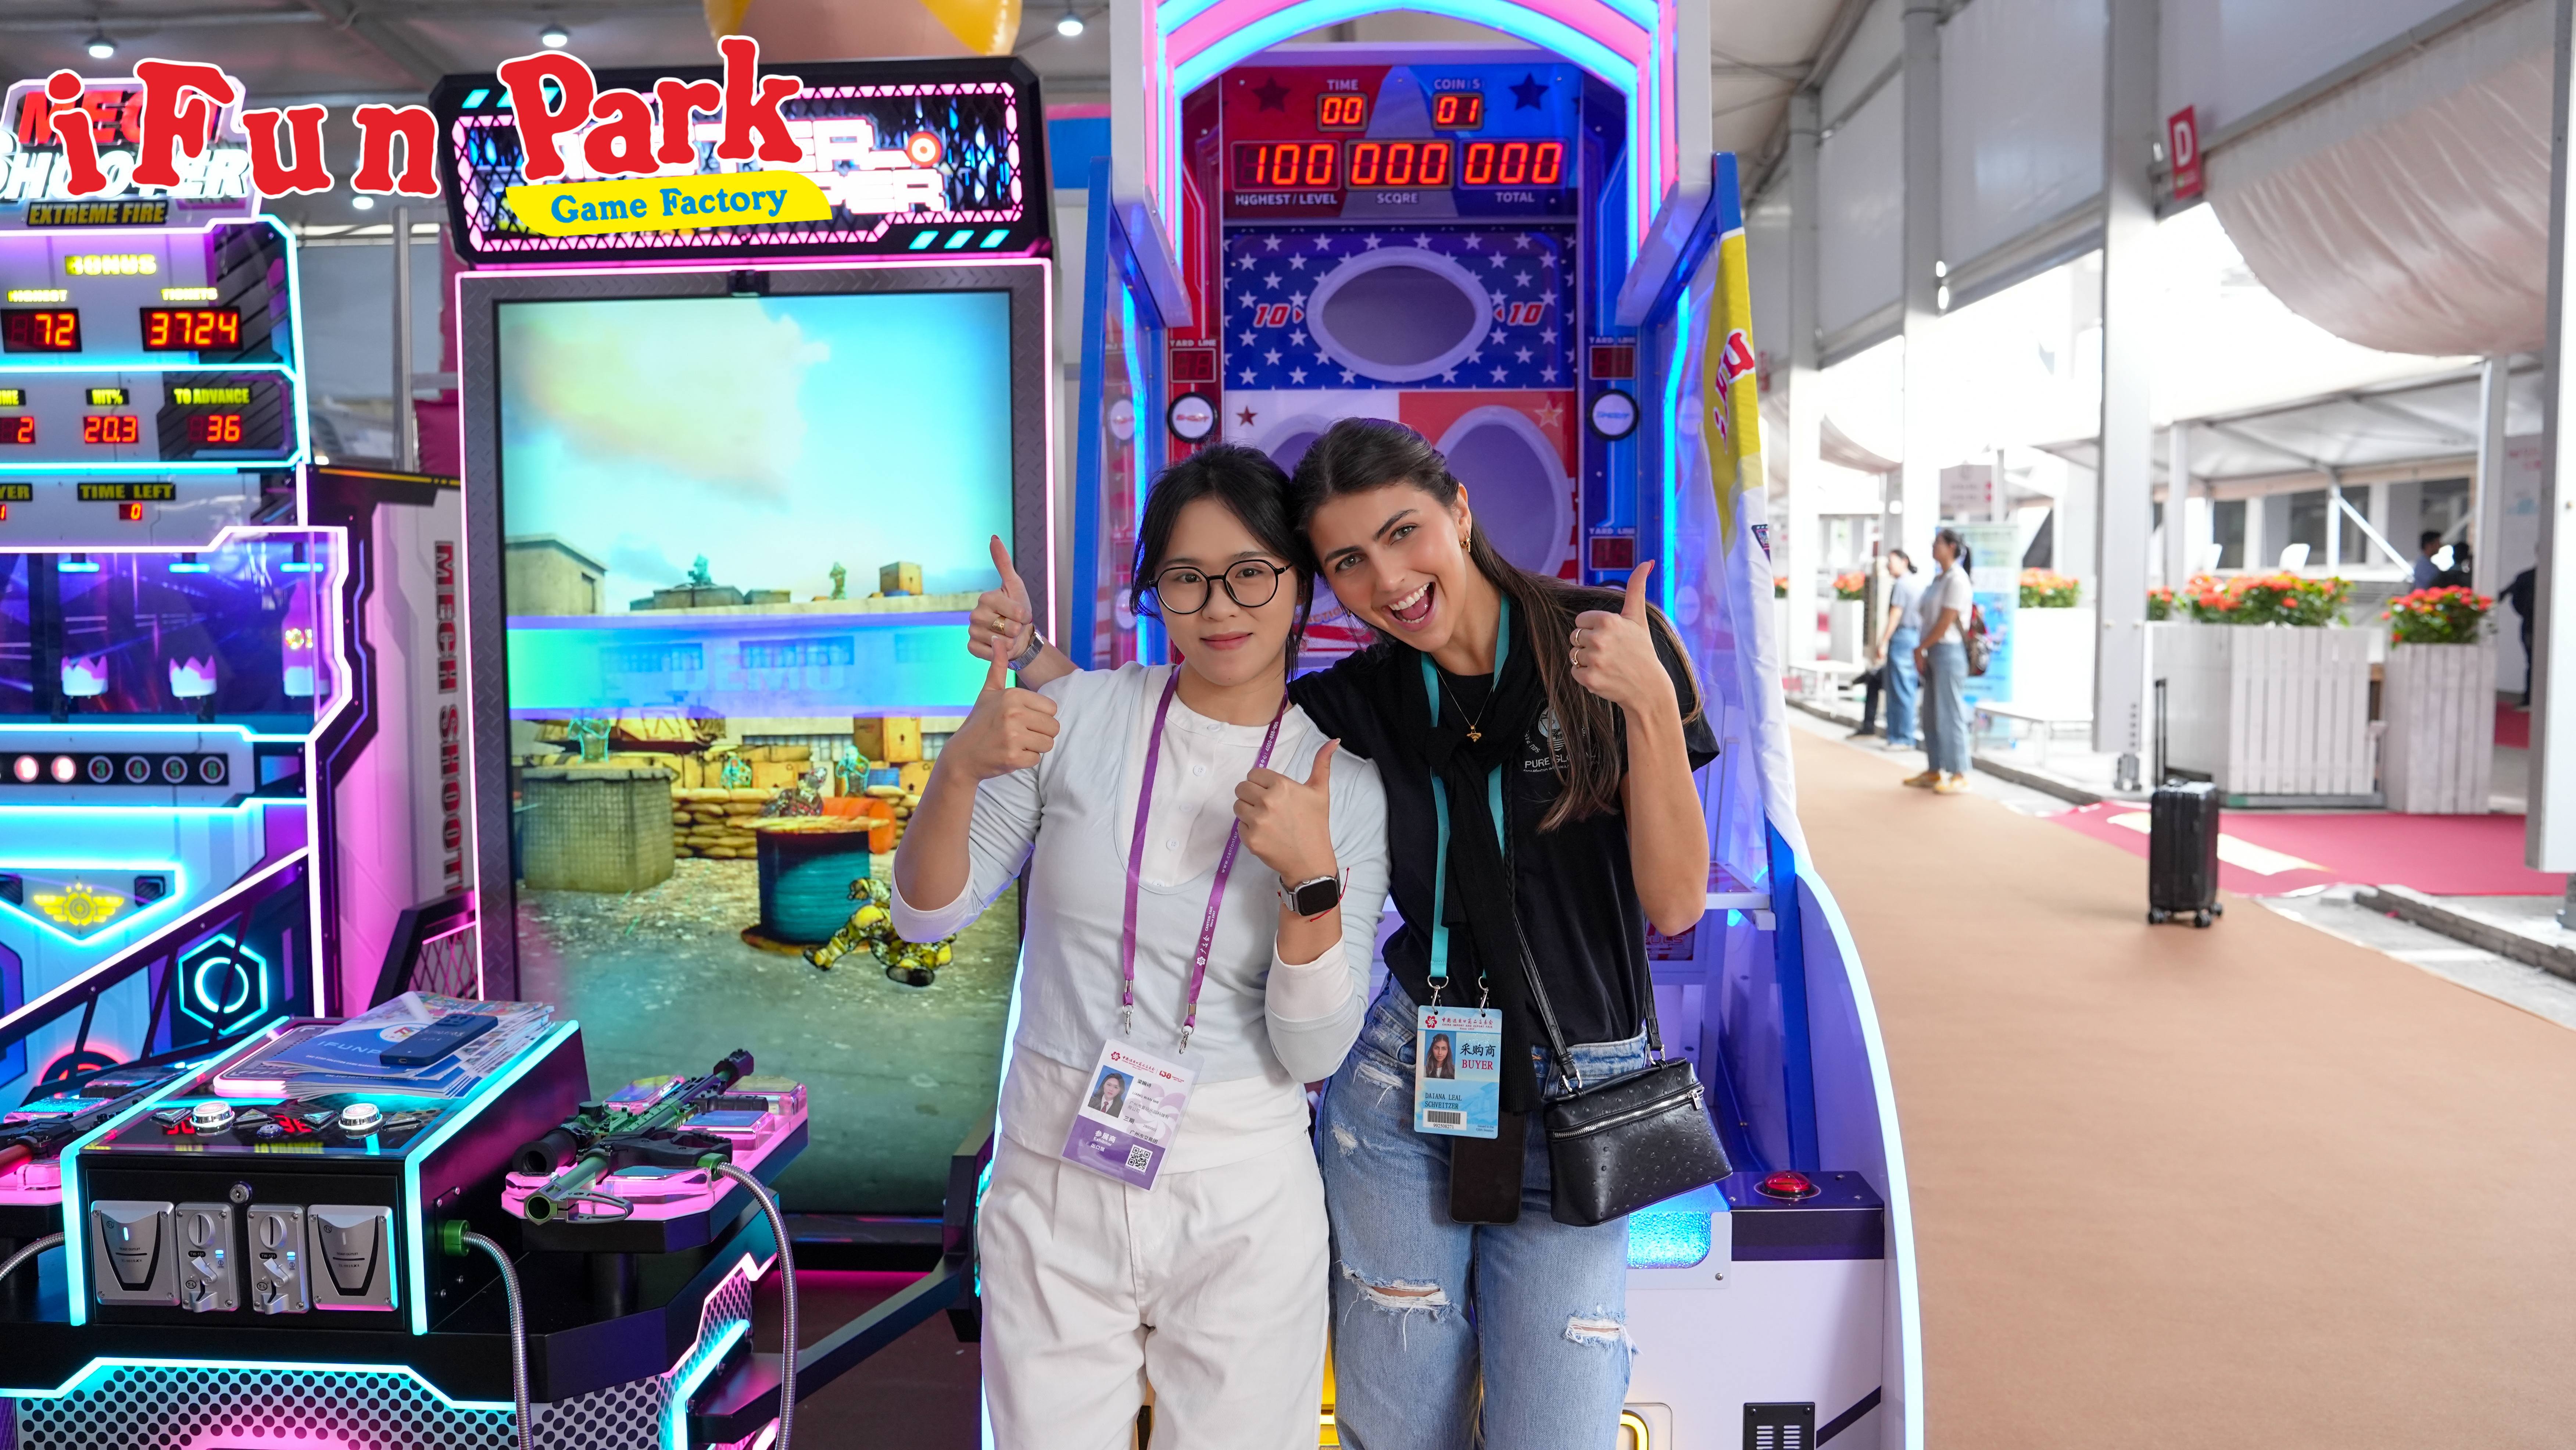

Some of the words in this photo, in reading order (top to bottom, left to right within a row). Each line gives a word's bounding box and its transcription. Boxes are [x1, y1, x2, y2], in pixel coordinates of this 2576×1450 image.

[1327, 79, 1359, 90] TIME
[1322, 97, 1363, 124] 00
[1437, 97, 1479, 123] 01
[2173, 121, 2193, 167] D
[1256, 144, 1334, 185] 100
[1351, 143, 1448, 184] 000
[1465, 143, 1562, 184] 000
[1377, 193, 1418, 204] SCORE
[1496, 192, 1535, 203] TOTAL
[31, 203, 118, 224] EXTREME
[121, 203, 166, 223] FIRE
[65, 254, 157, 276] BONUS
[1254, 304, 1291, 328] 10
[1507, 303, 1543, 325] 10
[35, 314, 74, 346] 72
[149, 313, 237, 345] 3724
[174, 389, 192, 404] TO
[193, 388, 249, 404] ADVANCE
[18, 417, 34, 442] 2
[207, 415, 241, 441] 36
[80, 485, 125, 499] TIME
[133, 484, 172, 499] LEFT
[130, 503, 142, 520] 0
[434, 541, 458, 693] MECH
[96, 762, 105, 776] 3
[132, 762, 142, 777] 4
[1525, 757, 1550, 768] PURE
[1460, 1043, 1496, 1057] 采购商
[1462, 1060, 1493, 1070] BUYER
[1123, 1115, 1135, 1124] 三期
[1094, 1136, 1112, 1147] Exhibitor
[1095, 1130, 1116, 1143] 参展商
[1130, 1130, 1158, 1144] 广州市交易团
